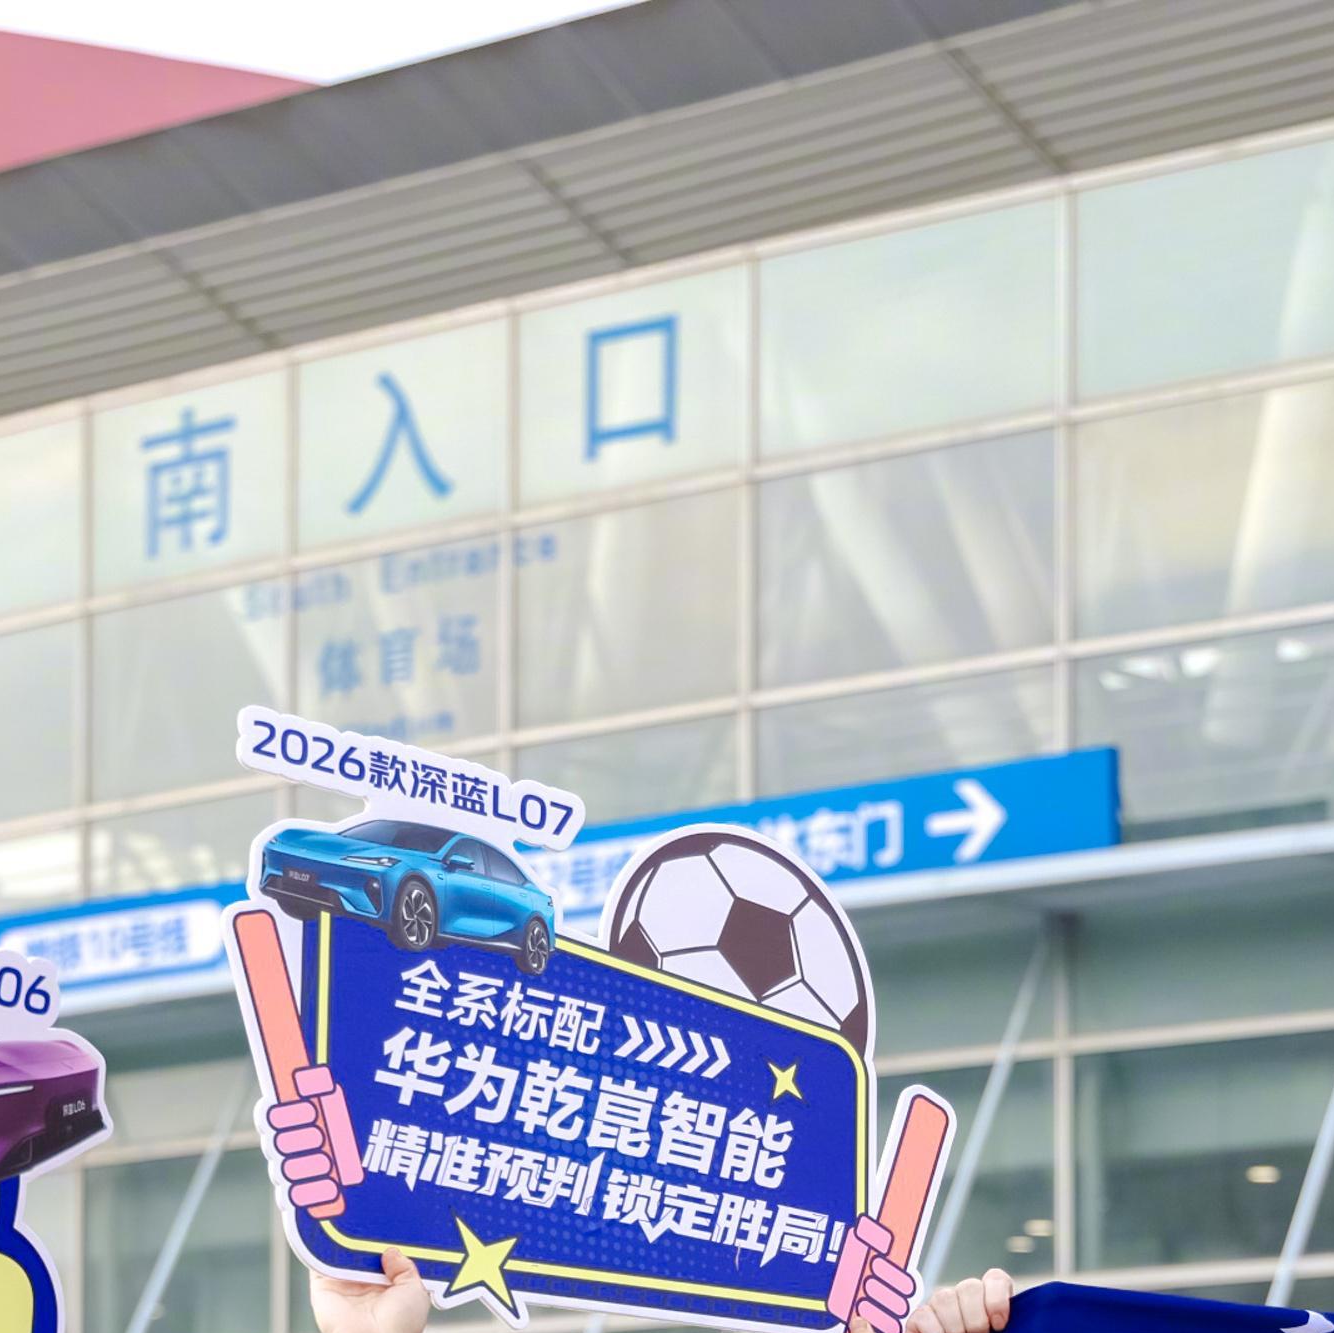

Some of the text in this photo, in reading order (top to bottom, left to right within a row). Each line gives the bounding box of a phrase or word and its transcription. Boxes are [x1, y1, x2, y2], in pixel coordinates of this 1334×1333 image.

[139, 312, 679, 560] 南入口
[251, 719, 575, 838] 2026款深蓝L07
[394, 960, 607, 1057] 全系标配
[373, 1027, 796, 1191] 华为乾崑智能
[362, 1119, 847, 1268] 精准预判 锁定胜局!
